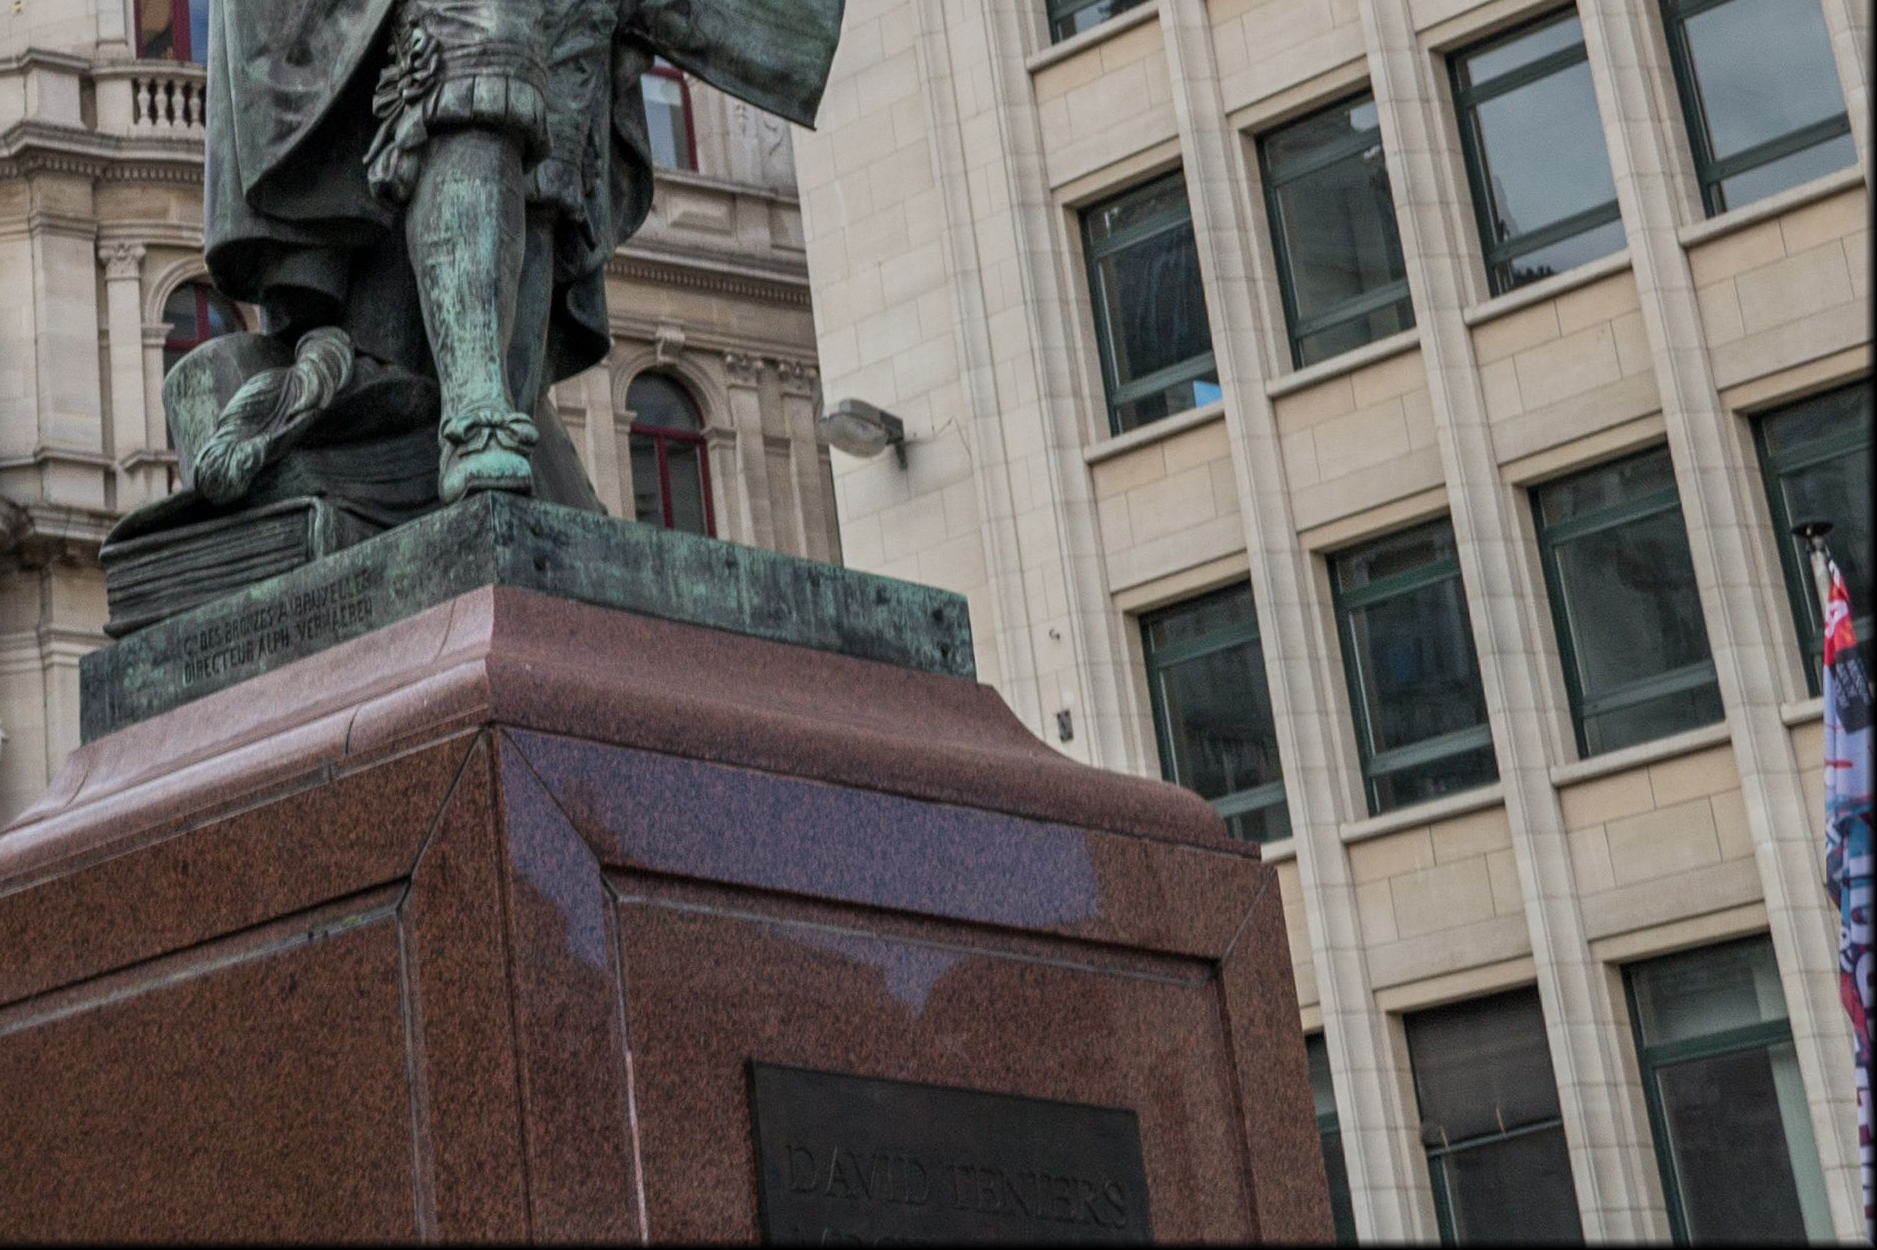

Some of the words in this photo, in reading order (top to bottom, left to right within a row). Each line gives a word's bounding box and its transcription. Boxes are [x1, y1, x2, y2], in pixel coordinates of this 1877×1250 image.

[183, 637, 254, 684] DIRECTEUR
[786, 1143, 929, 1206] DAVID
[946, 1163, 1128, 1230] TENIERS
